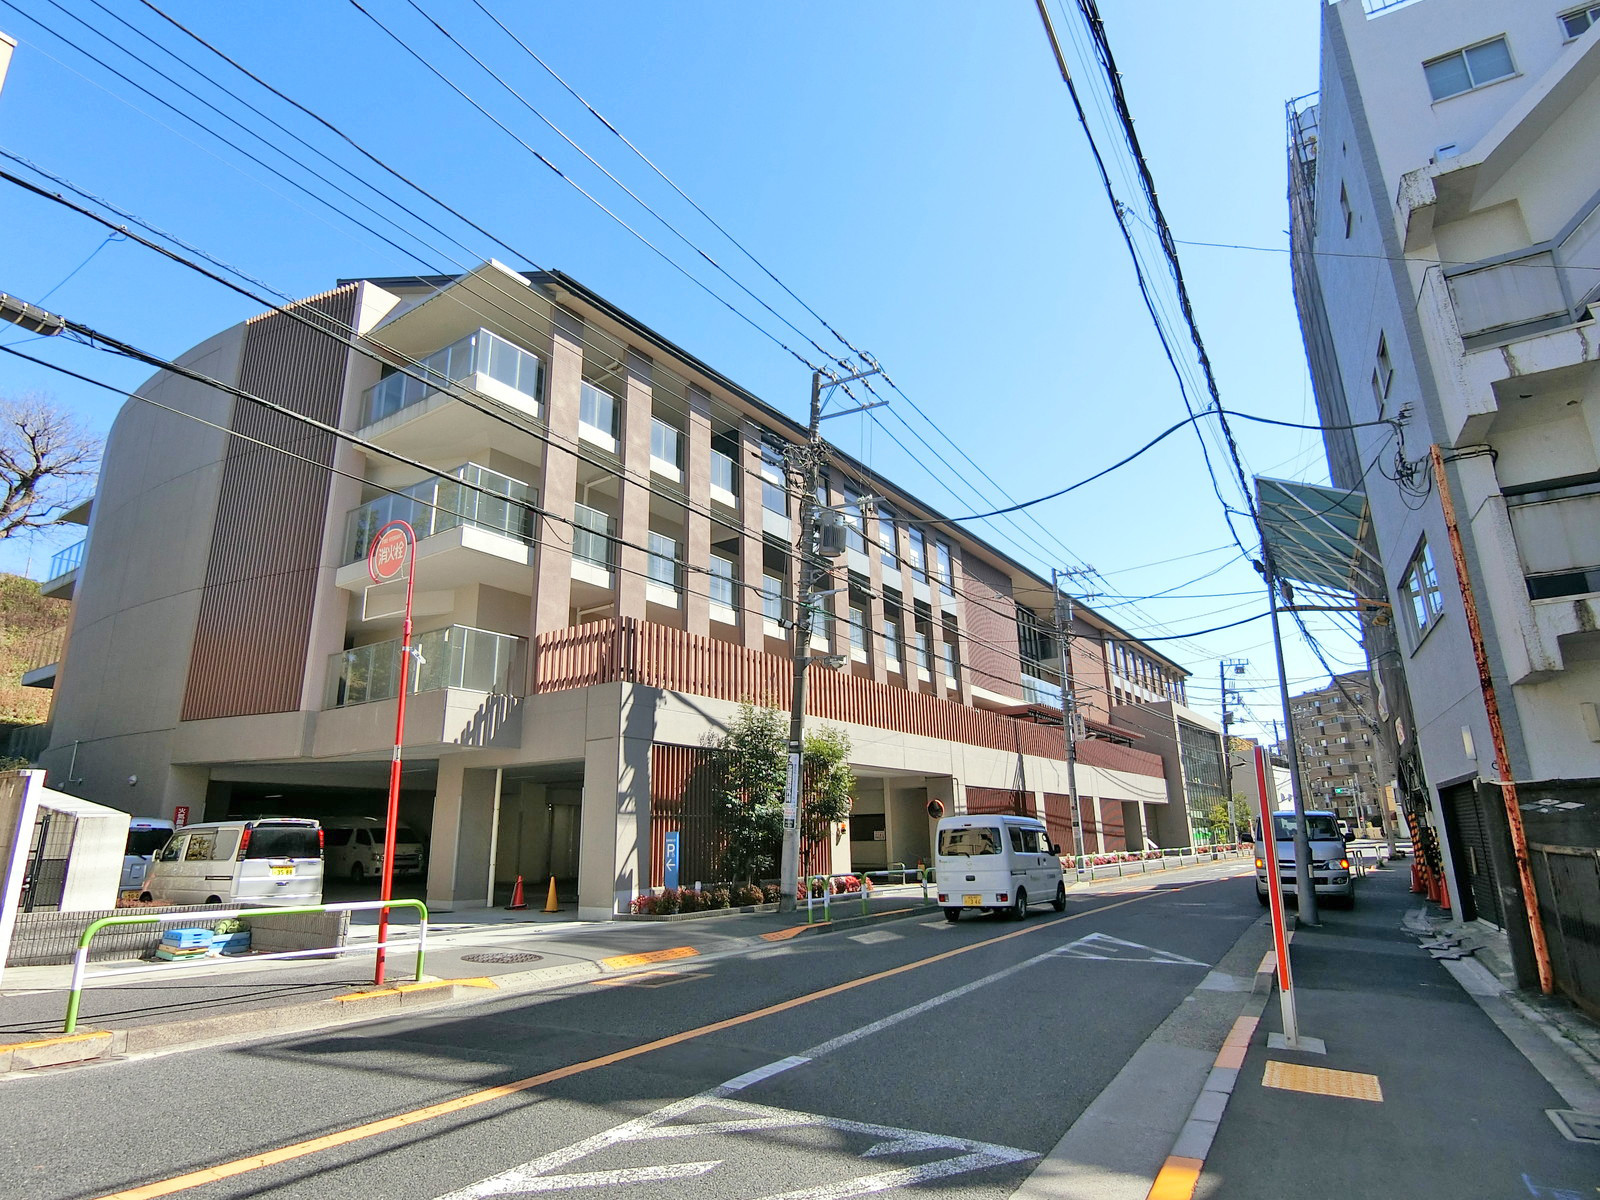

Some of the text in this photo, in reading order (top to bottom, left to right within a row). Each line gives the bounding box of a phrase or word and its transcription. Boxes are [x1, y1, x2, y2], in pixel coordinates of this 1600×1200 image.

[378, 541, 404, 565] 消火栓
[667, 843, 675, 857] P
